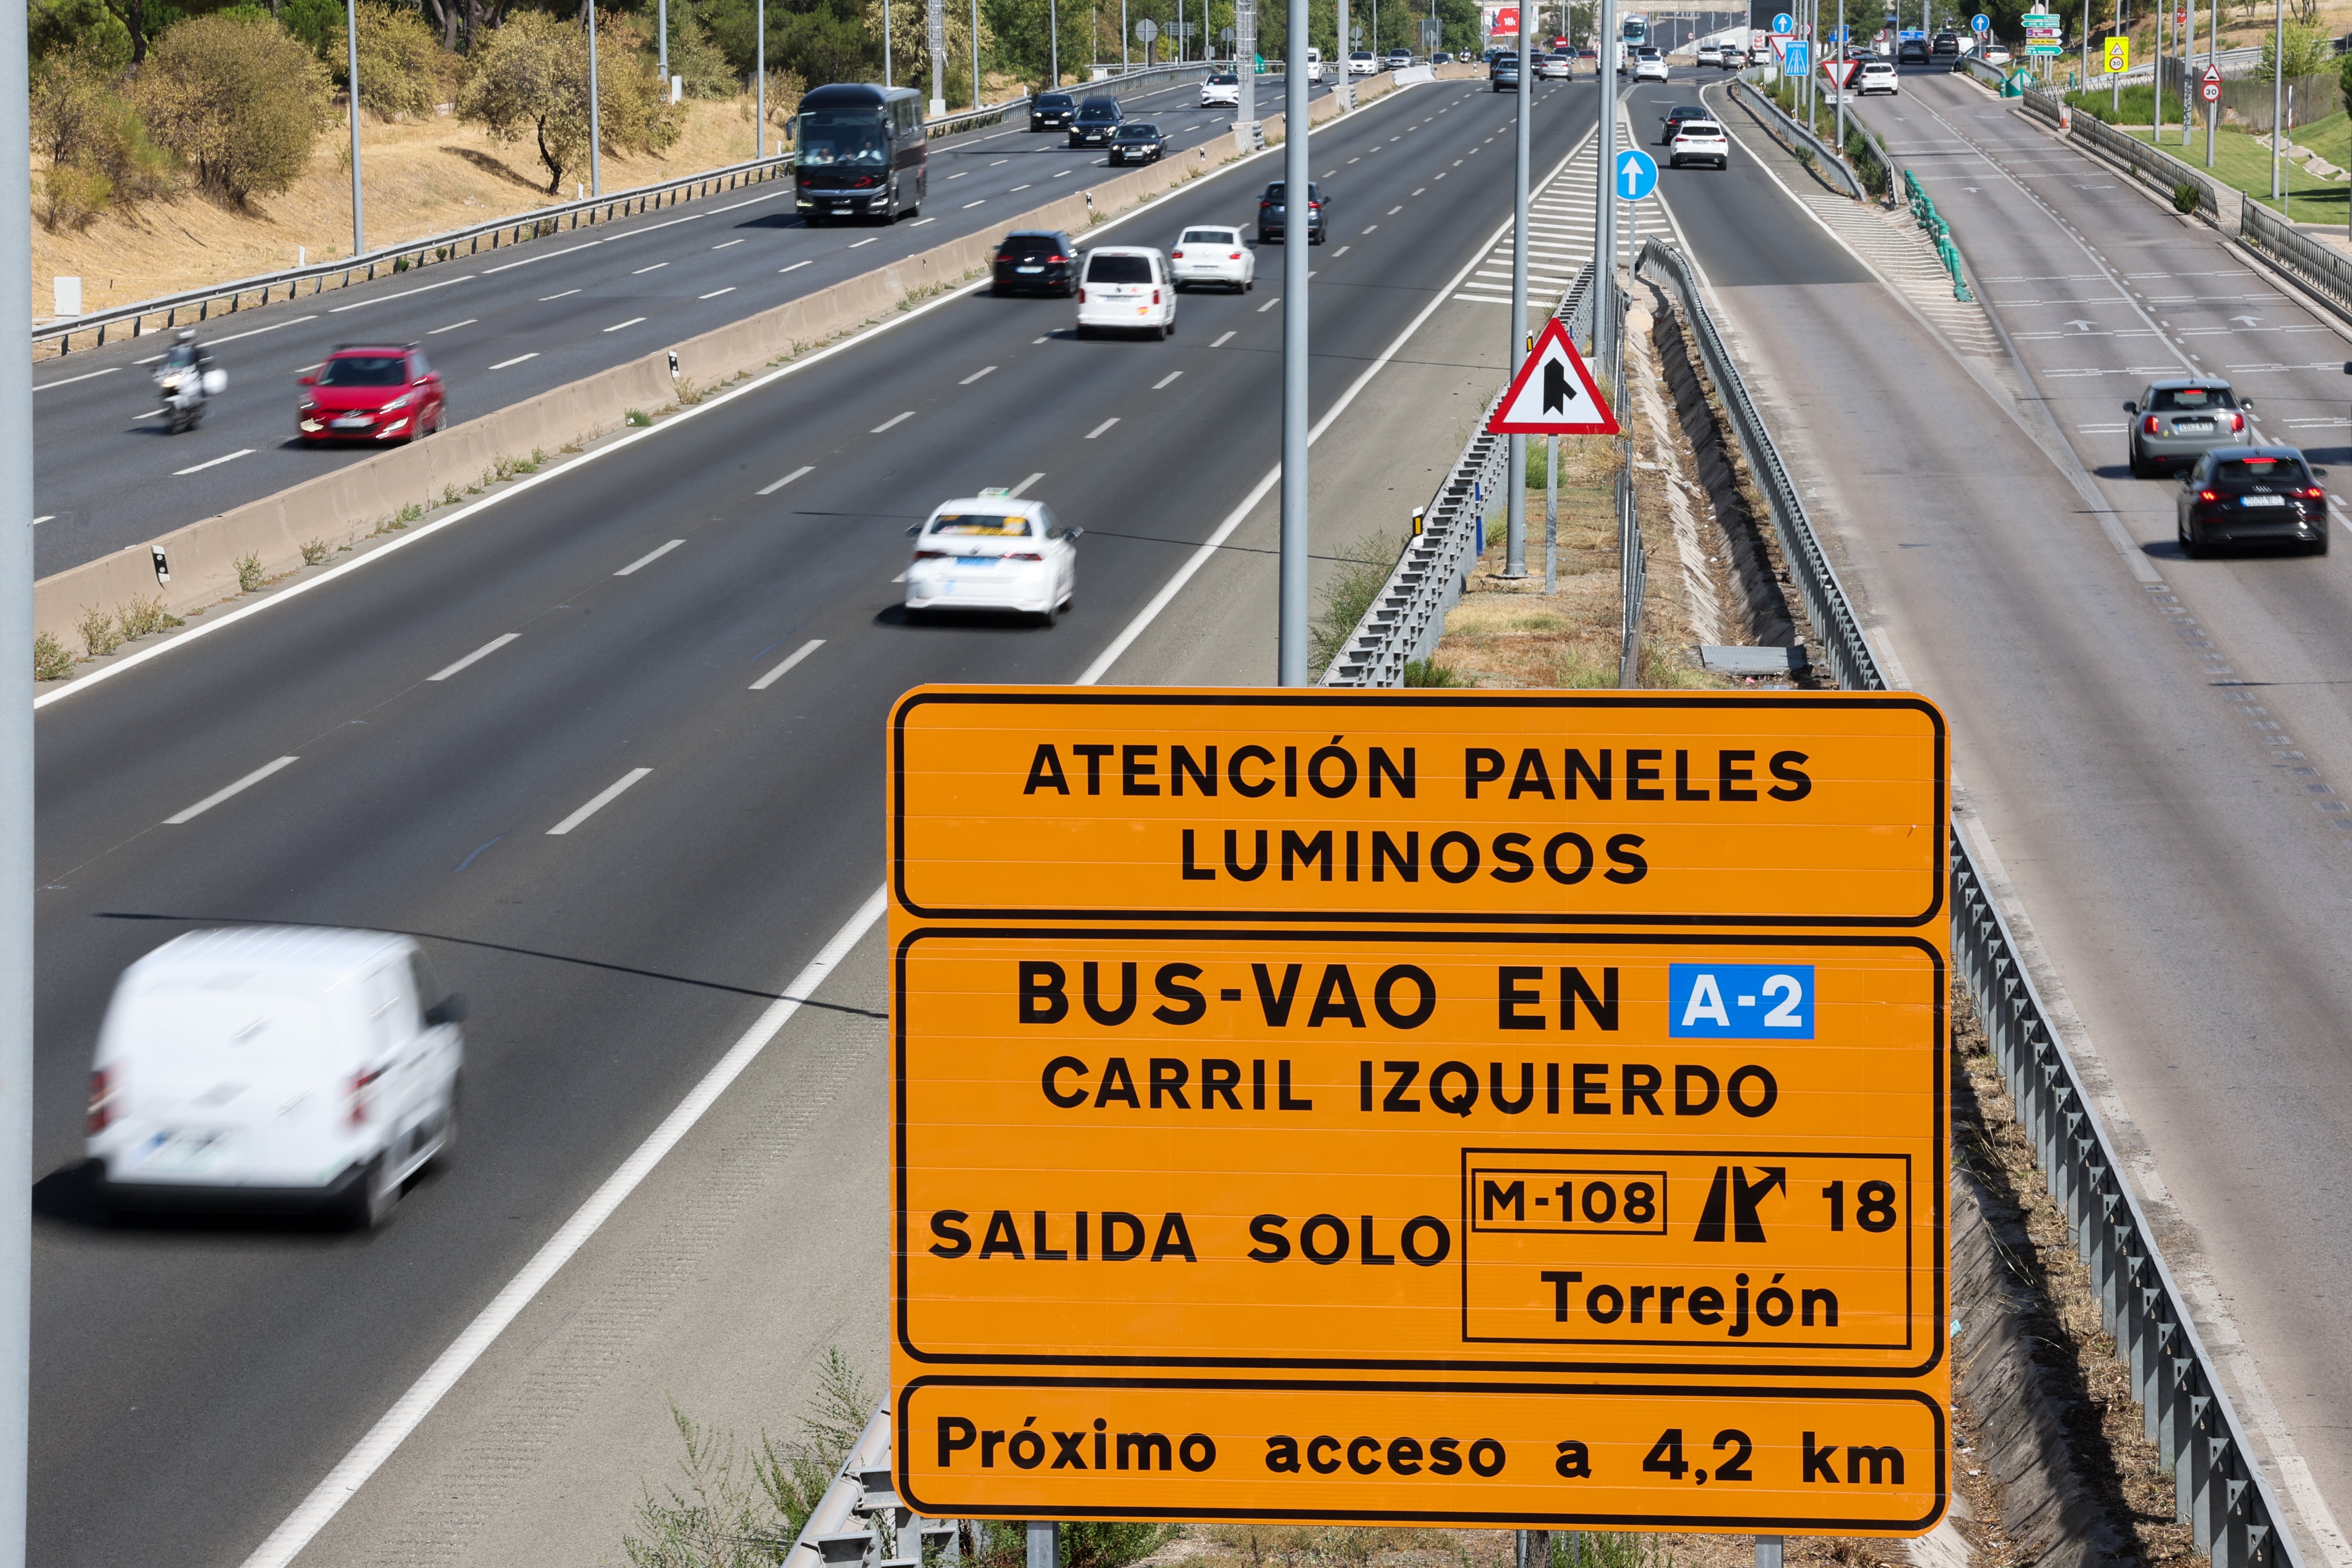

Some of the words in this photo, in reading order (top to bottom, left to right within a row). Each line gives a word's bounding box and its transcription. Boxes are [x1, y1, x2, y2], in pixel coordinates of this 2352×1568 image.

[1024, 735, 1415, 798] ATENCIÓN
[1466, 748, 1811, 801] PANELES
[1183, 829, 1647, 884] LUMINOSOS
[1019, 961, 1436, 1029] BUS-VAO
[1499, 966, 1618, 1030] EN
[1682, 975, 1802, 1026] A-2
[1042, 1056, 1312, 1110] CARRIL
[1361, 1061, 1777, 1117] IZQUIERDO
[1484, 1181, 1655, 1223] M-108
[1823, 1180, 1896, 1232] 18
[929, 1210, 1197, 1262] SALIDA
[1248, 1214, 1450, 1266] SOLO
[1542, 1272, 1837, 1337] Torrejón
[938, 1417, 1216, 1472] Próximo
[1266, 1435, 1505, 1477] acceso
[1556, 1441, 1591, 1478] a
[1643, 1429, 1752, 1485] 4,2
[1803, 1432, 1904, 1484] km
